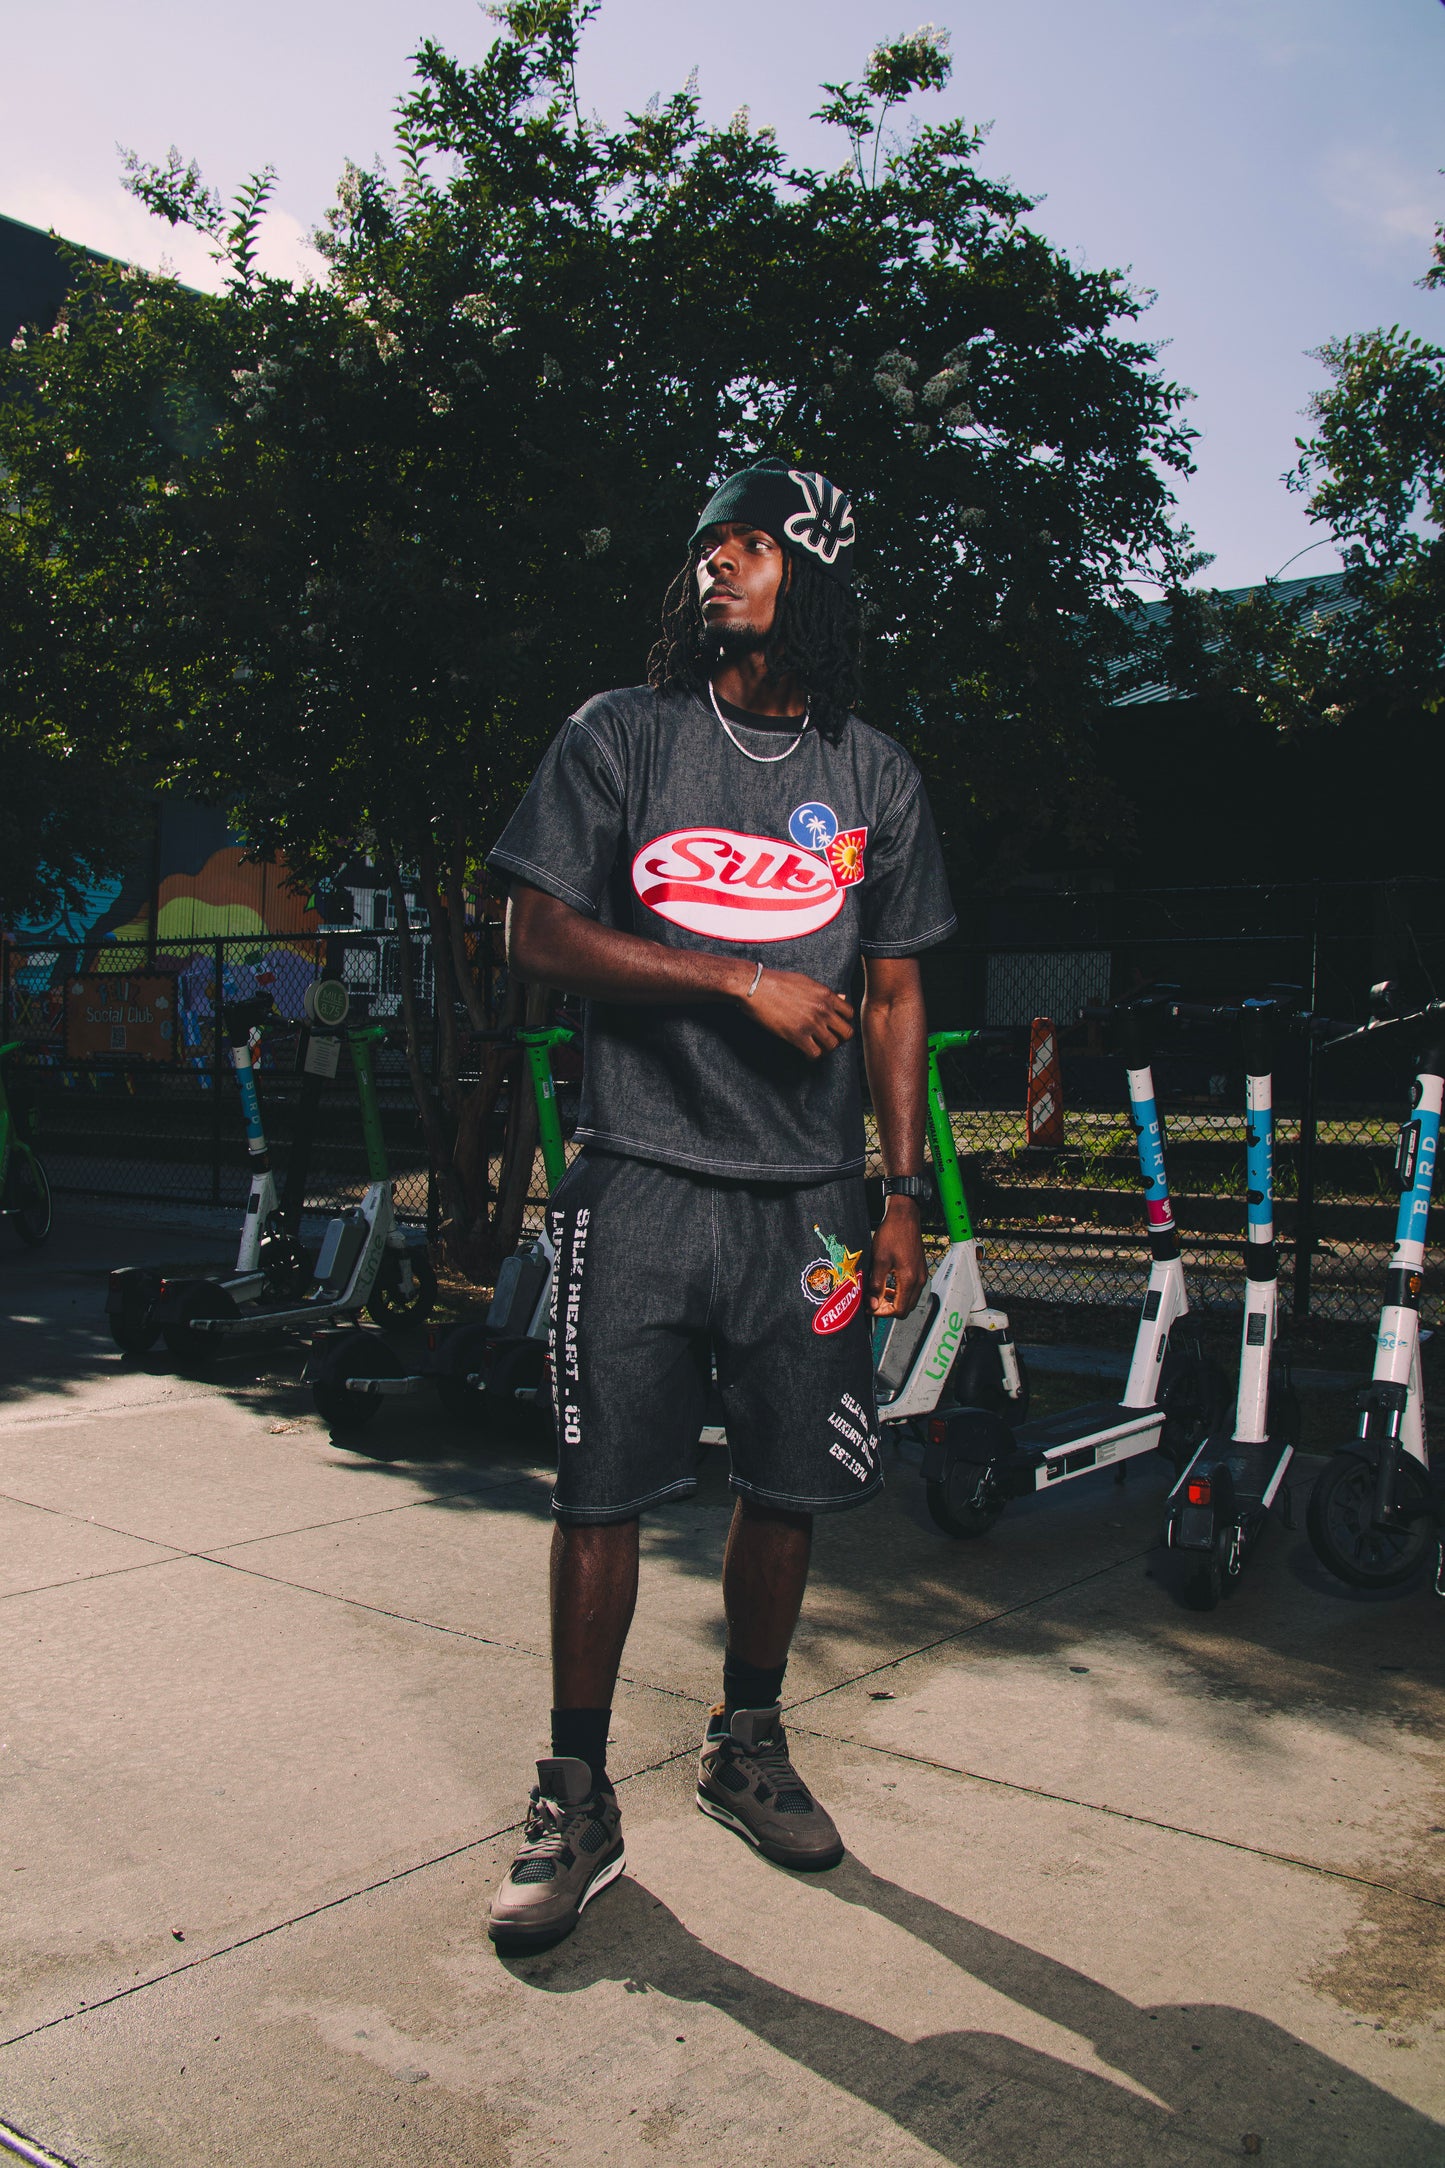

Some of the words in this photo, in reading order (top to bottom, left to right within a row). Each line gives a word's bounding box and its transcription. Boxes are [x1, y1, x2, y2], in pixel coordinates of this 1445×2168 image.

[645, 837, 833, 894] Silk
[86, 1006, 124, 1024] Social
[127, 1006, 154, 1023] Club
[320, 1003, 341, 1018] 8.75
[323, 989, 345, 1005] MILE
[245, 1080, 261, 1125] BIRD
[934, 1144, 945, 1173] RIDING
[1149, 1120, 1167, 1186] BIRD
[1413, 1136, 1437, 1215] BIRD
[570, 1208, 590, 1277] SILK
[550, 1210, 565, 1323] LUXURY
[565, 1283, 582, 1381] HEART
[924, 1311, 963, 1380] Lime
[564, 1404, 581, 1444] CO
[827, 1411, 863, 1447] LUXURY
[829, 1442, 868, 1483] EST.1974
